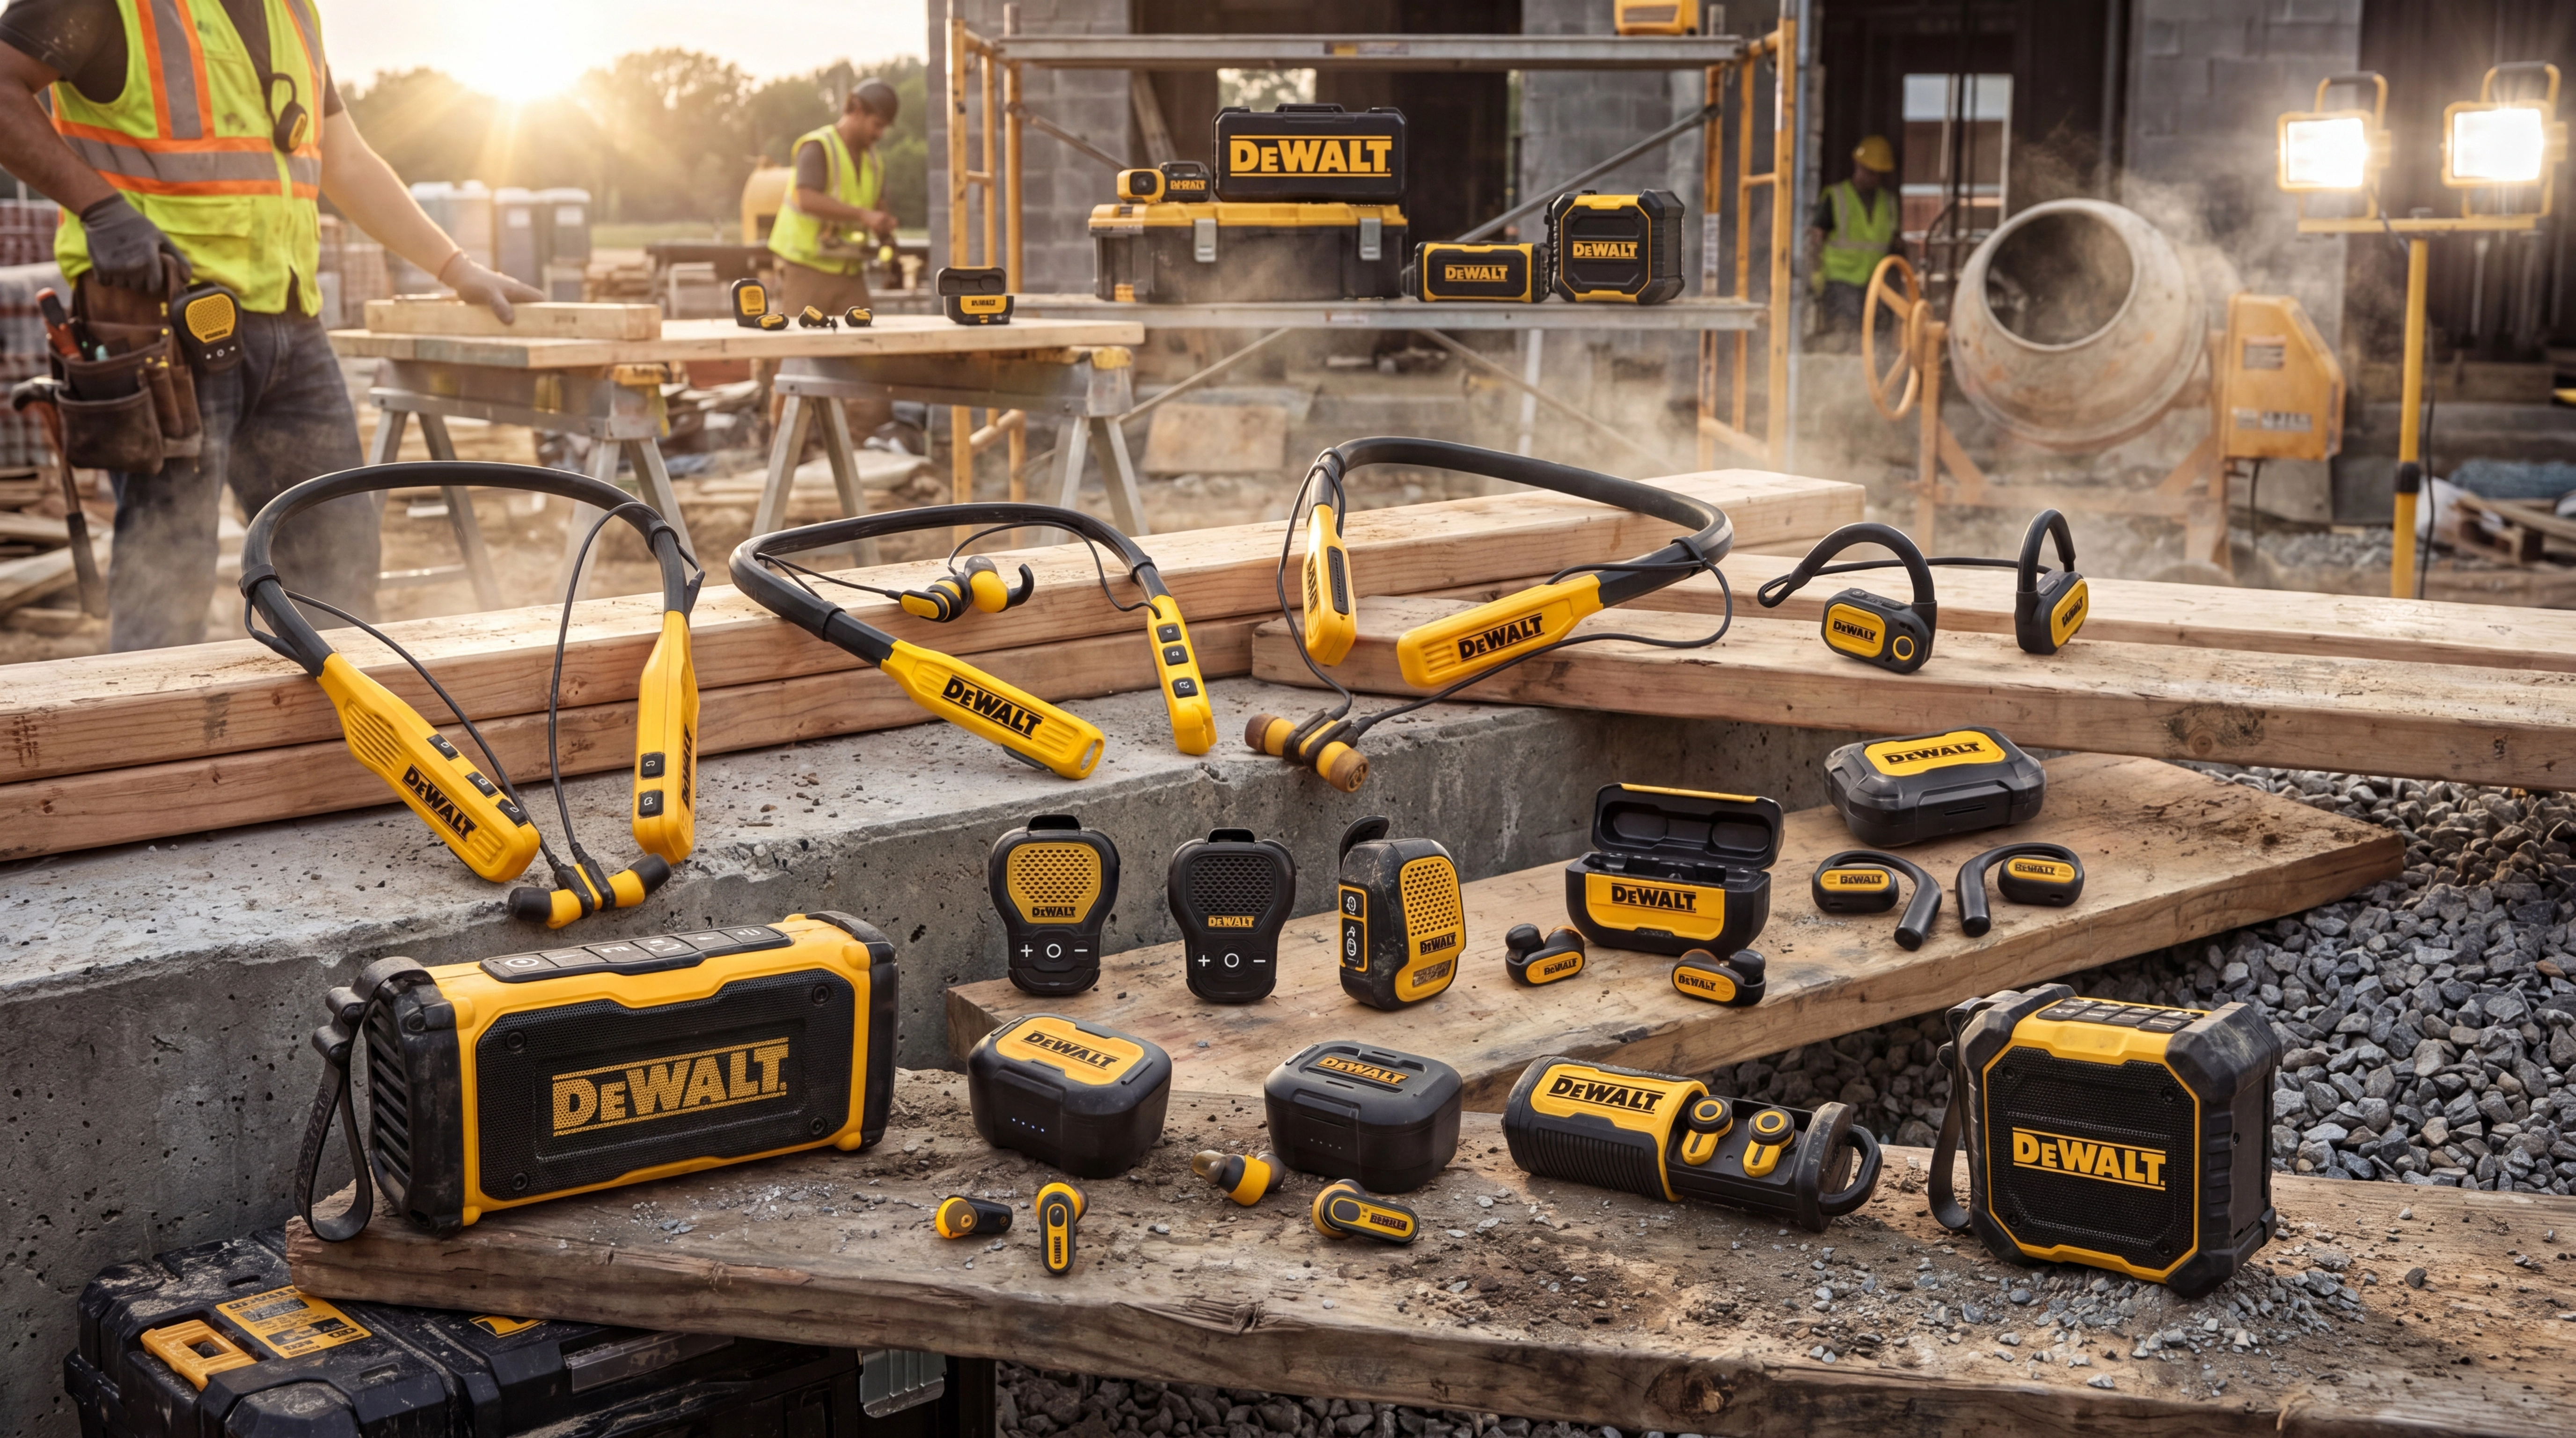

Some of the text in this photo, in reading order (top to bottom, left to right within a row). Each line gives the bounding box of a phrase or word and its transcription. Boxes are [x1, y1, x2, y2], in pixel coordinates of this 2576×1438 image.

[1230, 140, 1392, 172] DEWALT
[1573, 243, 1638, 257] DEWALT
[1445, 267, 1508, 280] DEWALT
[1458, 616, 1543, 659] DEWALT
[943, 677, 1042, 737] DEWALT
[1885, 742, 1980, 763] DEWALT
[403, 766, 476, 838] DEWALT
[1612, 885, 1697, 911] DEWALT
[1208, 916, 1255, 927] DEWALT
[1024, 1032, 1118, 1068] DEWALT
[1318, 1056, 1409, 1083] DEWALT
[553, 1043, 789, 1130] DEWALT
[1549, 1077, 1663, 1111] DEWALT
[2013, 1132, 2166, 1185] DEWALT
